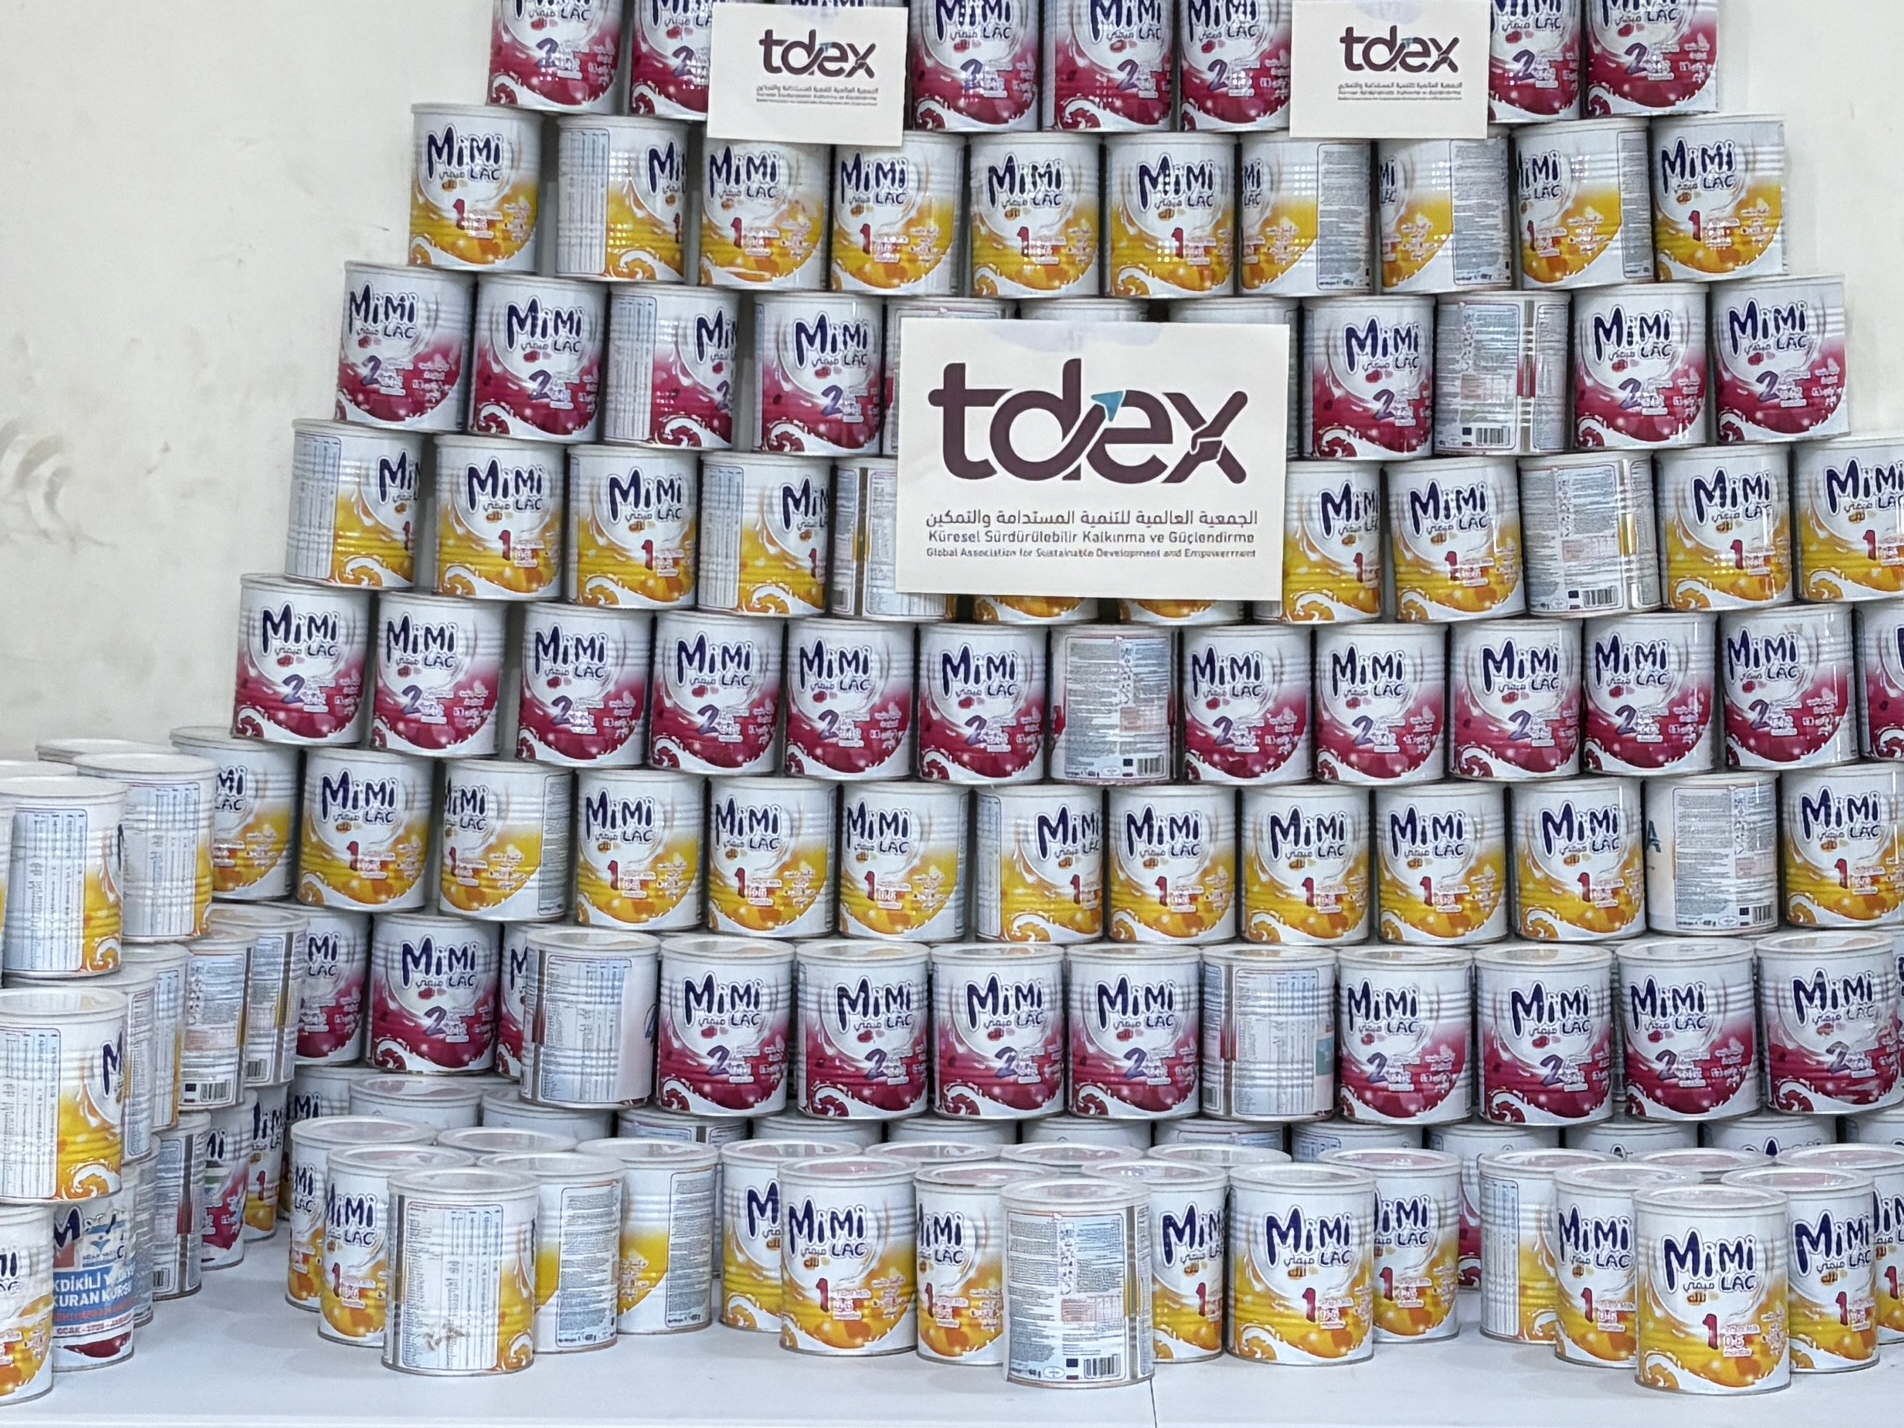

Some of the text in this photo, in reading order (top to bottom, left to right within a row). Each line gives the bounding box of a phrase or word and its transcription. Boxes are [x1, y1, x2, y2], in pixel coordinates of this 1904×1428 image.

[758, 29, 877, 79] tdex
[1339, 25, 1460, 73] tdex
[928, 358, 1248, 484] tdex
[926, 509, 1258, 528] الجمعية العالمية للتنمية المستدامة والتمكين
[929, 530, 1255, 545] Küresel Sürdürülebilir Kalkınma ve Güçlendirme
[926, 548, 958, 557] Global
[449, 972, 477, 988] LAC
[424, 1007, 447, 1035] 2
[731, 1013, 760, 1026] LAC
[886, 1014, 912, 1030] LAC
[1017, 1012, 1043, 1025] LAC
[1144, 1014, 1174, 1030] LAC
[1388, 1021, 1415, 1033] LAC
[1675, 1016, 1706, 1030] LAC
[1847, 1009, 1874, 1023] LAC
[1561, 1021, 1591, 1036] LAC
[706, 1046, 730, 1074] 2
[865, 1052, 886, 1080] 2
[995, 1047, 1018, 1079] 2
[1124, 1049, 1146, 1079] 2
[1367, 1053, 1388, 1082] 2
[1655, 1049, 1679, 1079] 2
[1825, 1042, 1850, 1072] 2
[1540, 1056, 1564, 1085] 2
[833, 1243, 866, 1257] LAC
[1320, 1250, 1351, 1266] LAC
[1596, 1255, 1630, 1267] LAC
[1848, 1252, 1872, 1268] LAC
[1722, 1275, 1753, 1290] LAC
[815, 1278, 829, 1312] 1
[1302, 1287, 1317, 1322] 1
[1580, 1286, 1594, 1323] 1
[1835, 1291, 1848, 1326] 1
[1702, 1313, 1718, 1350] 1
